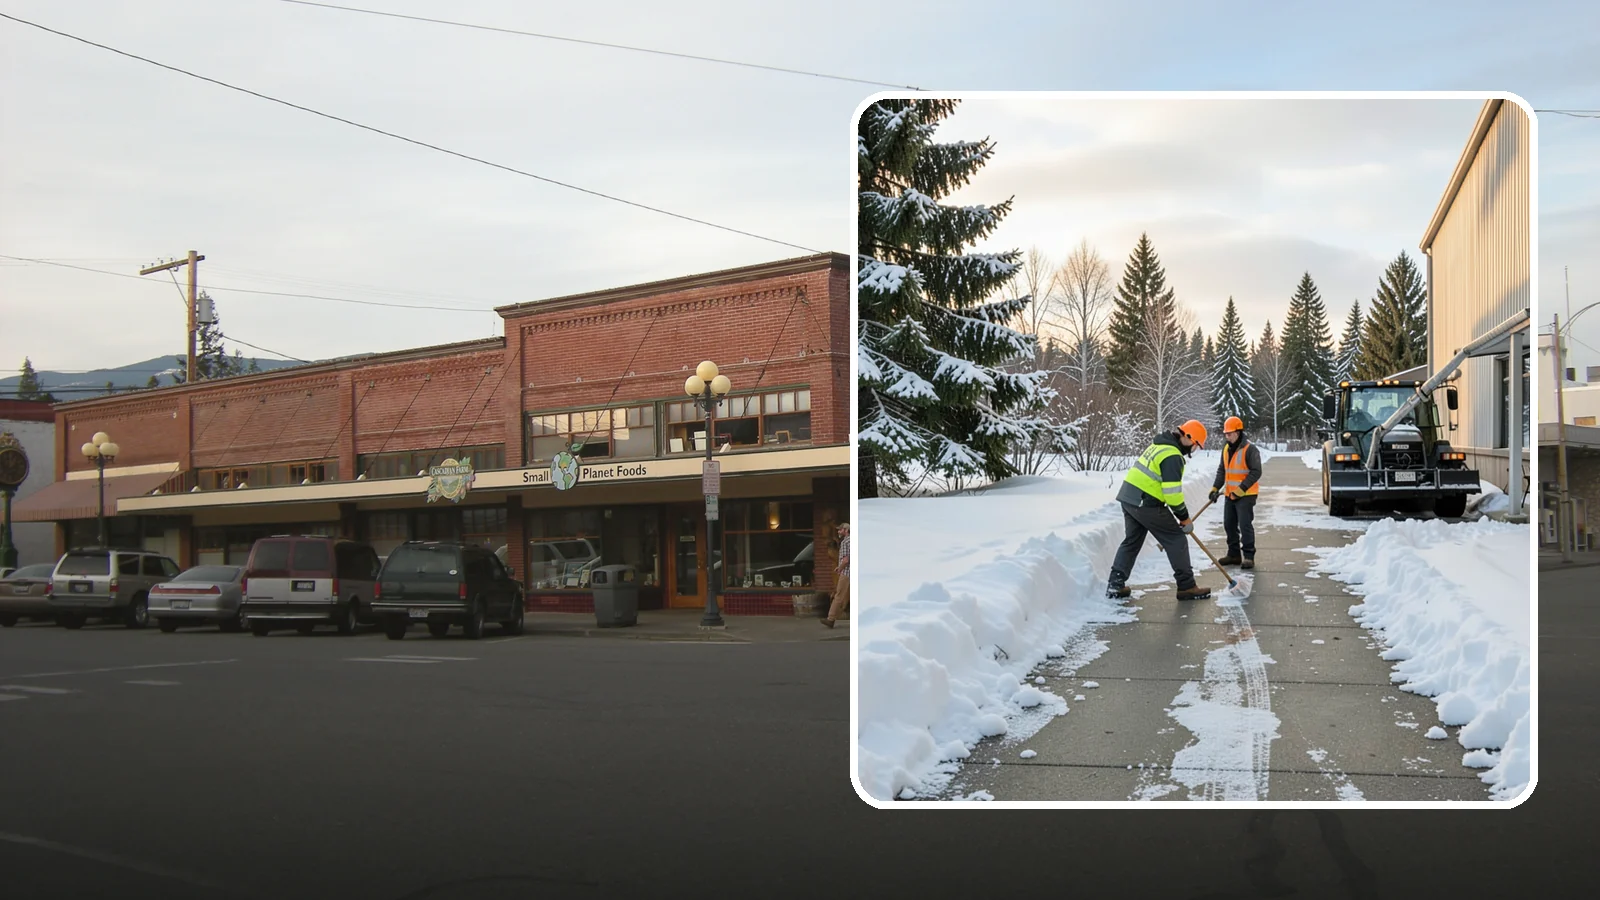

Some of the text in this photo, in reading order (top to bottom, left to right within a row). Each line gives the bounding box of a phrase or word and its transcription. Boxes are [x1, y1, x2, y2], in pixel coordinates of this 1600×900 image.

[523, 464, 647, 482] Small Planet Foods
